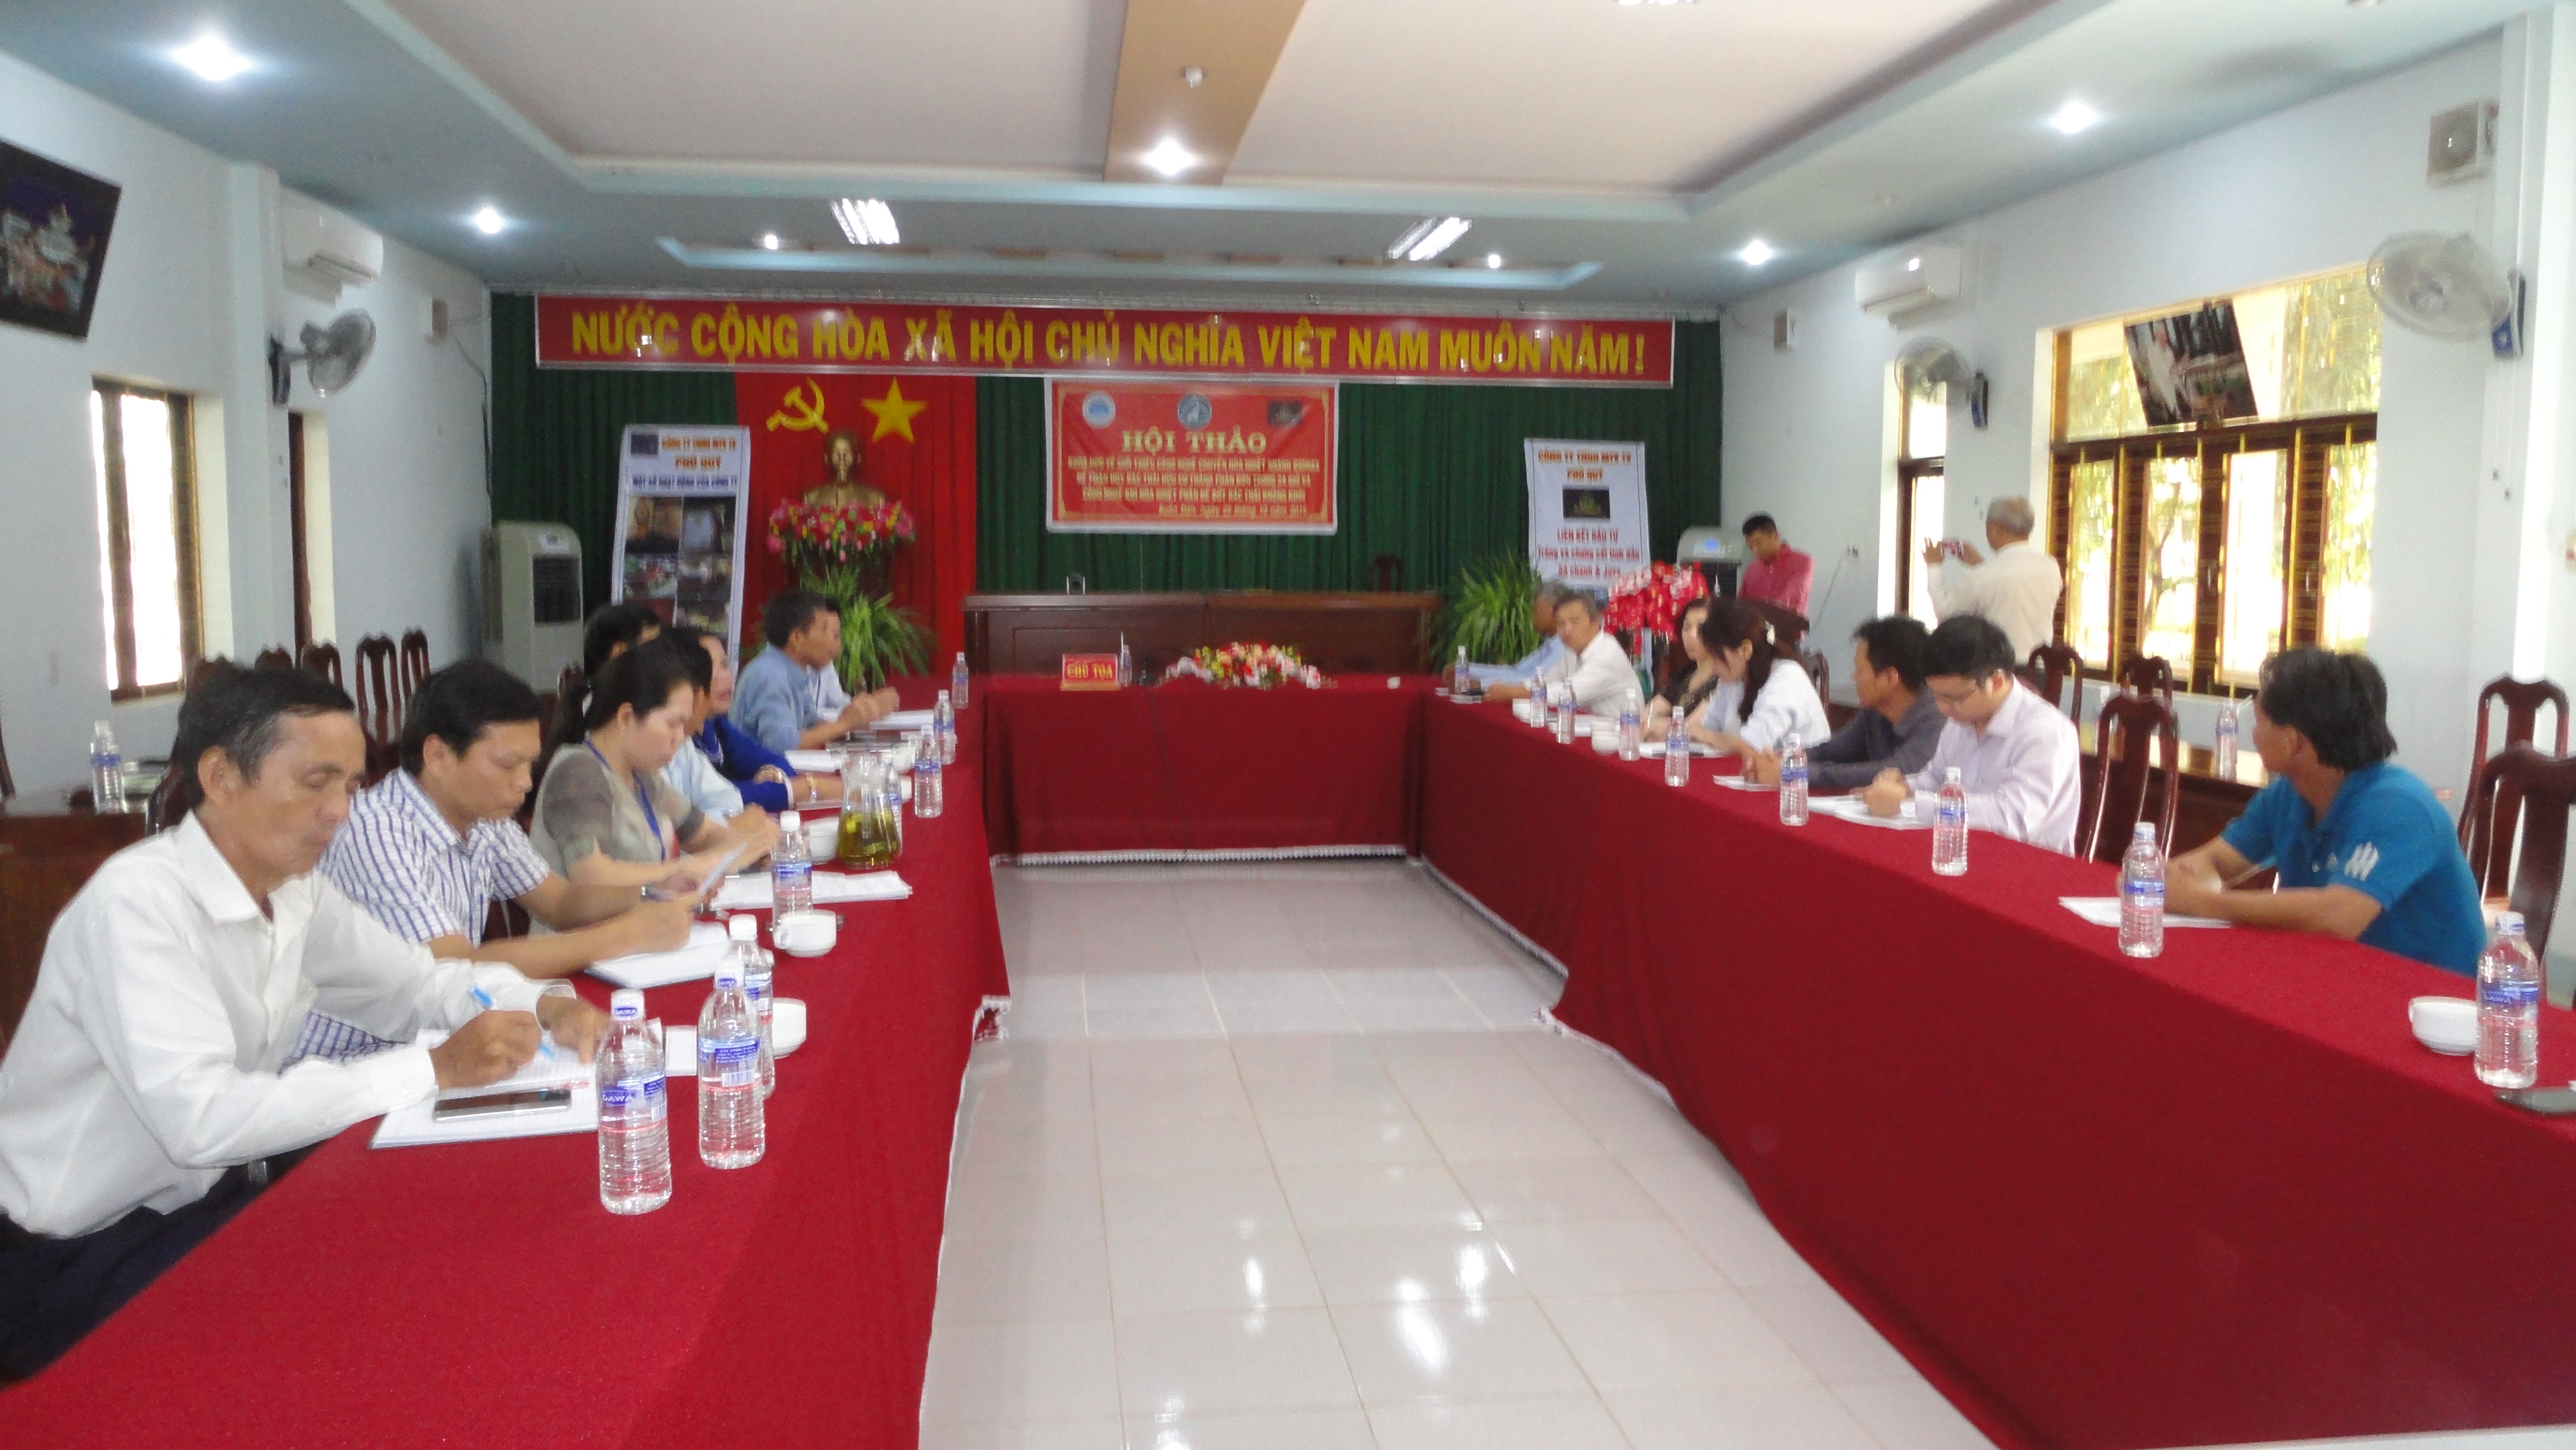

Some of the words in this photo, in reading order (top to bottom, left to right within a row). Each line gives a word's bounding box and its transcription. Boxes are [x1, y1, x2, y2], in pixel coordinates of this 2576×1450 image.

[572, 302, 679, 357] NƯỚC
[691, 303, 799, 364] CỘNG
[812, 309, 890, 361] HÒA
[905, 309, 957, 362] XÃ
[970, 309, 1033, 370] HỘI
[1045, 308, 1120, 365] CHỦ
[1134, 314, 1244, 367] NGHĨA
[1258, 317, 1336, 373] VIỆT
[1348, 327, 1429, 370] NAM
[1439, 321, 1543, 373] MUÔN
[1122, 426, 1175, 456] HỘI
[1185, 425, 1267, 454] THẢO
